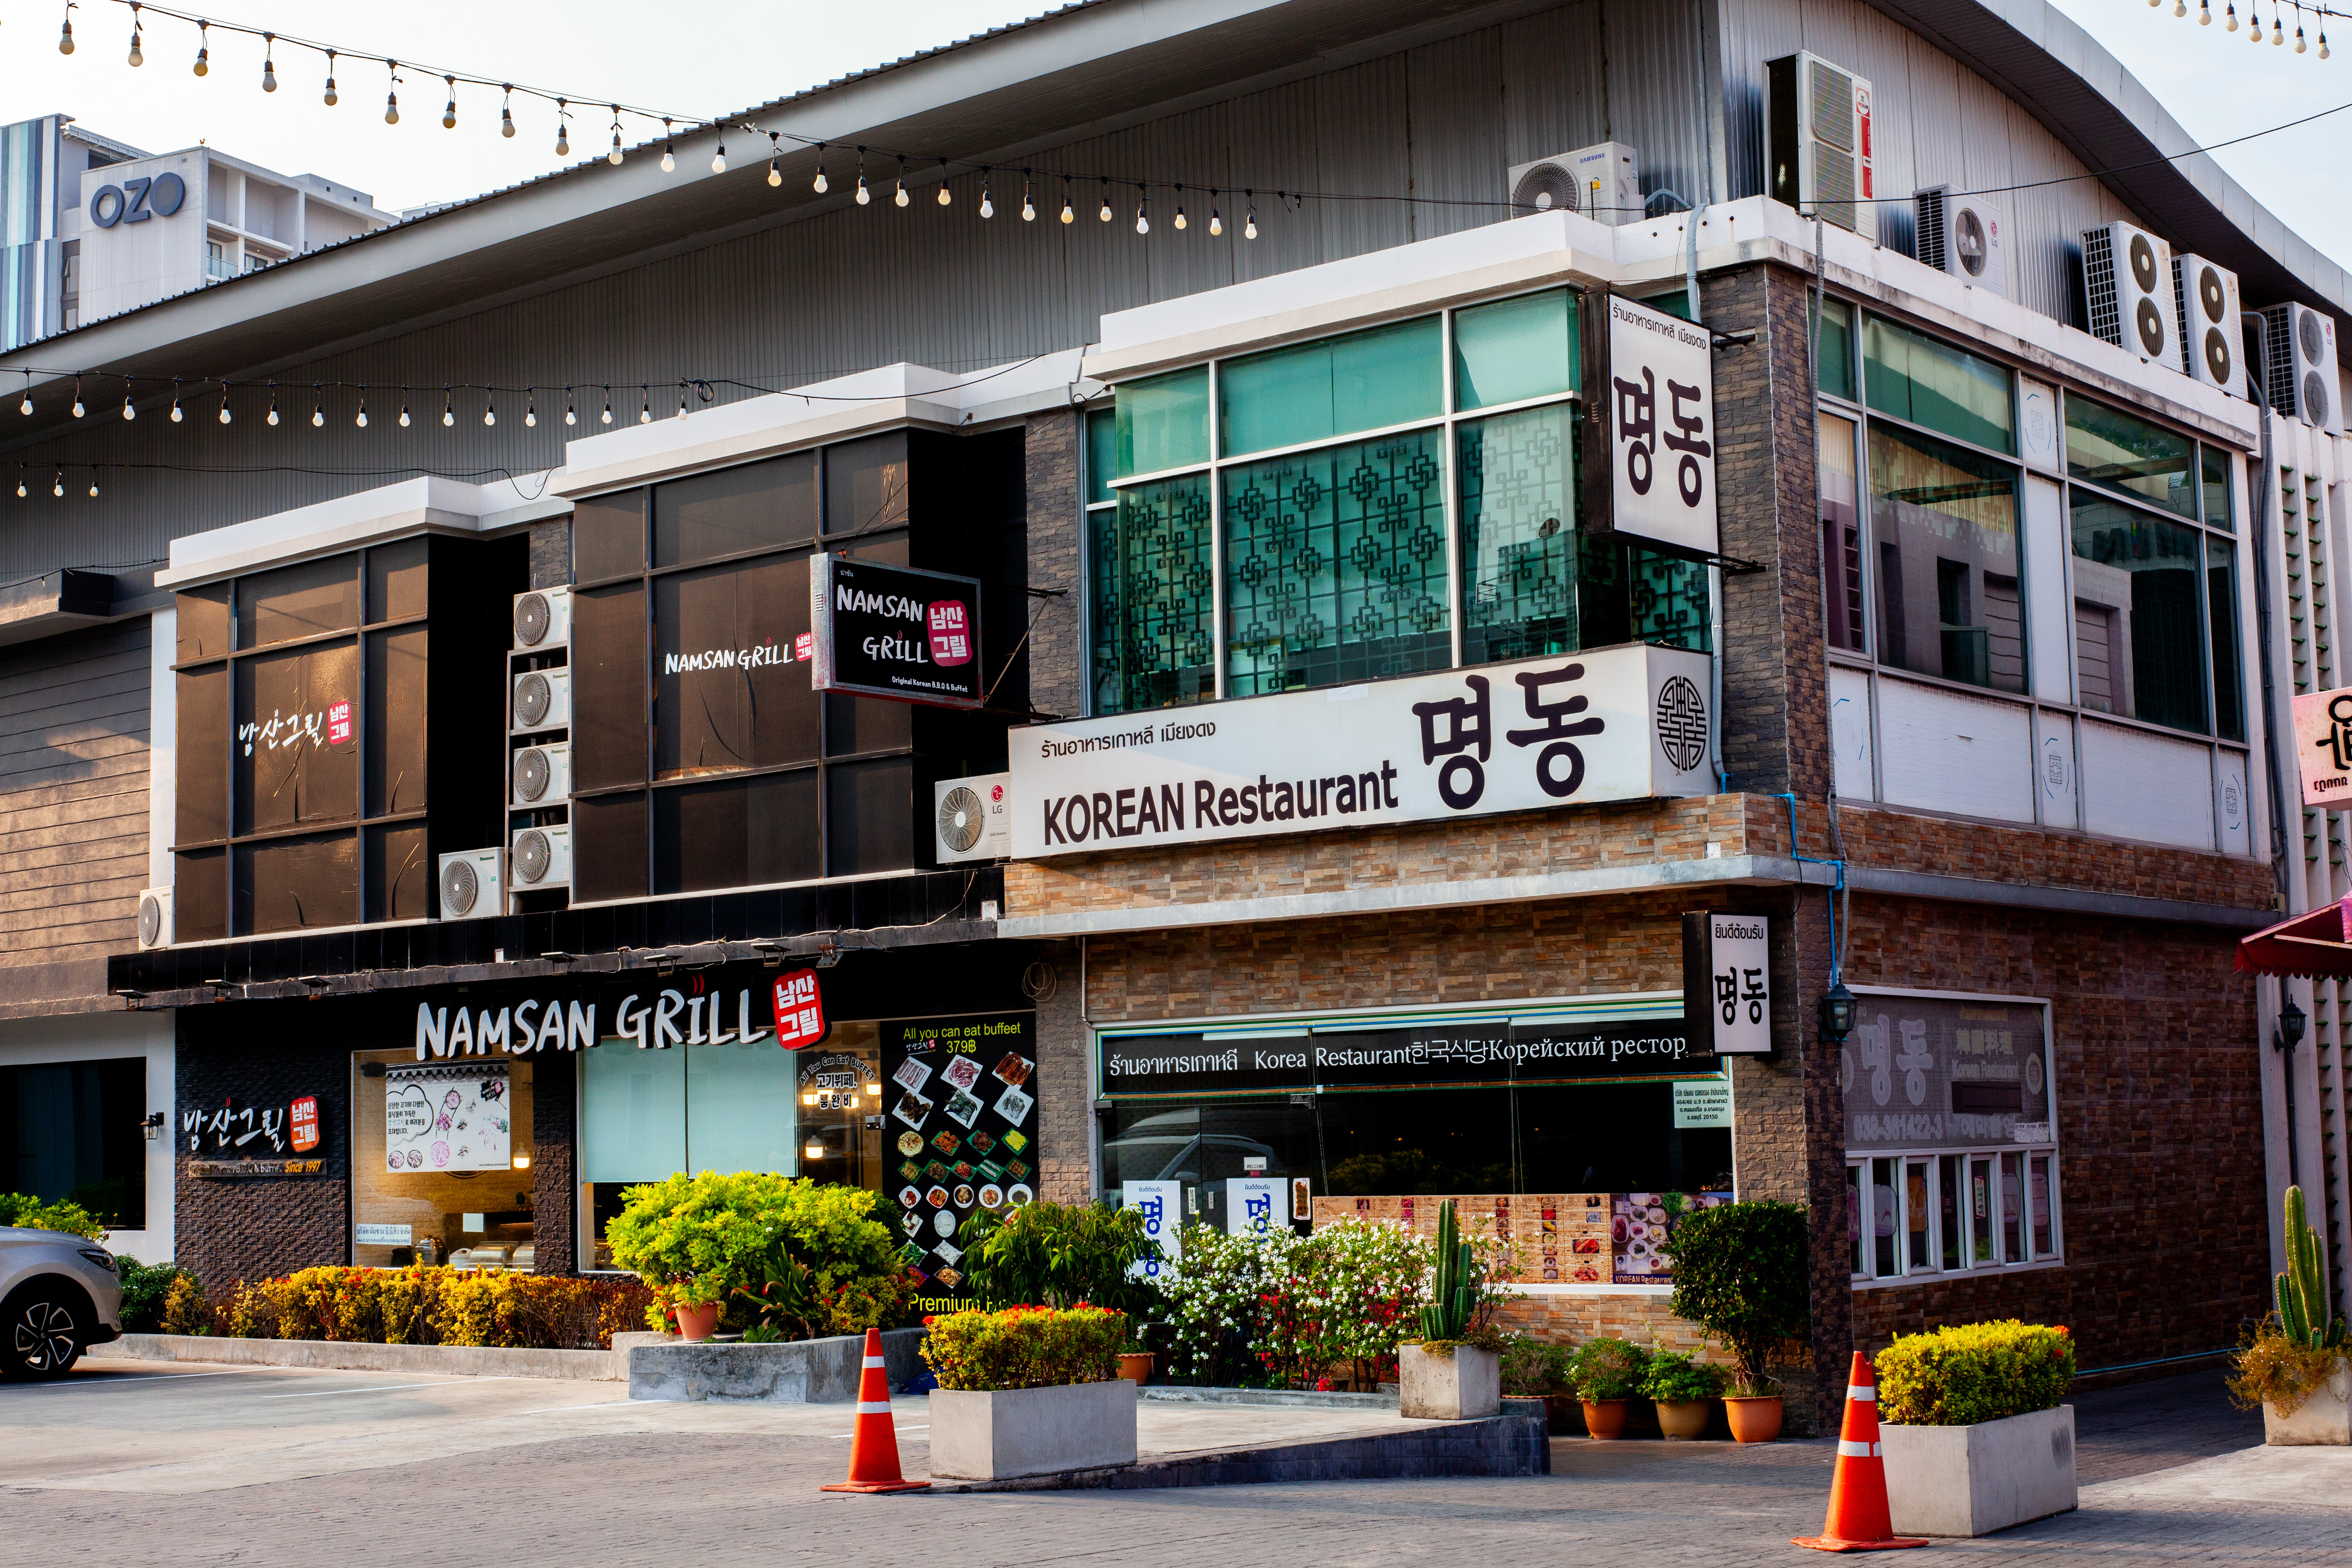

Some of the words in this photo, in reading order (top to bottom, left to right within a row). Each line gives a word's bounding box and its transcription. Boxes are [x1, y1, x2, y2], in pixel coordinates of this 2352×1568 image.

[1580, 153, 1605, 163] SAMSUNG
[90, 172, 185, 228] OZO
[1991, 238, 1997, 248] LG
[1613, 303, 1674, 339] ร้านอาหารเกาหลี
[1613, 365, 1711, 507] 명동
[837, 584, 923, 622] NAMSAN
[930, 606, 963, 630] 남산
[797, 634, 811, 646] 남산
[863, 636, 928, 663] GRILL
[934, 635, 967, 658] 그릴
[665, 650, 735, 675] NAMSAN
[738, 644, 794, 670] GRILL
[892, 676, 912, 686] Original
[913, 678, 931, 688] Korean
[932, 681, 946, 690] B.B.Q
[951, 683, 968, 693] Buffet
[330, 704, 348, 722] 남산
[331, 722, 349, 740] 그릴
[1041, 725, 1154, 758] ร้านอาหารเกาหลี
[1161, 722, 1216, 743] เมียงดง
[1412, 663, 1605, 810] 명동
[993, 805, 1002, 814] LG
[1044, 782, 1185, 846] KOREAN
[1194, 759, 1399, 829] Restaurant
[1715, 923, 1763, 940] ยินดีต้อนรับ
[776, 975, 815, 1011] 남산
[1715, 967, 1767, 1026] 명동
[416, 999, 596, 1061] NAMSAN
[616, 988, 769, 1049] GRILL
[779, 1008, 820, 1042] 그릴
[903, 1028, 916, 1039] All
[919, 1029, 938, 1042] you
[941, 1026, 960, 1037] can
[964, 1024, 981, 1036] eat
[984, 1022, 1021, 1035] buffeet
[1110, 1048, 1238, 1076] ร้านอาหารเกาหลี
[1255, 1050, 1307, 1069] Korea
[1316, 1046, 1411, 1067] Restaurant
[1411, 1040, 1489, 1065] 한국식당
[1488, 1036, 1605, 1065] Корейский
[1858, 1014, 1933, 1106] 명동
[800, 1071, 809, 1086] All
[807, 1062, 821, 1074] You
[822, 1057, 835, 1066] Can
[837, 1055, 849, 1064] Eat
[851, 1057, 875, 1081] BUFFET
[1952, 1060, 1980, 1078] Korean
[1981, 1060, 2019, 1079] Restaurant
[292, 1101, 315, 1122] 남산
[293, 1123, 316, 1145] 그릴
[254, 1163, 259, 1172] &
[285, 1161, 302, 1173] Since
[305, 1161, 321, 1173] 1997
[1615, 1275, 1640, 1284] KOREAN
